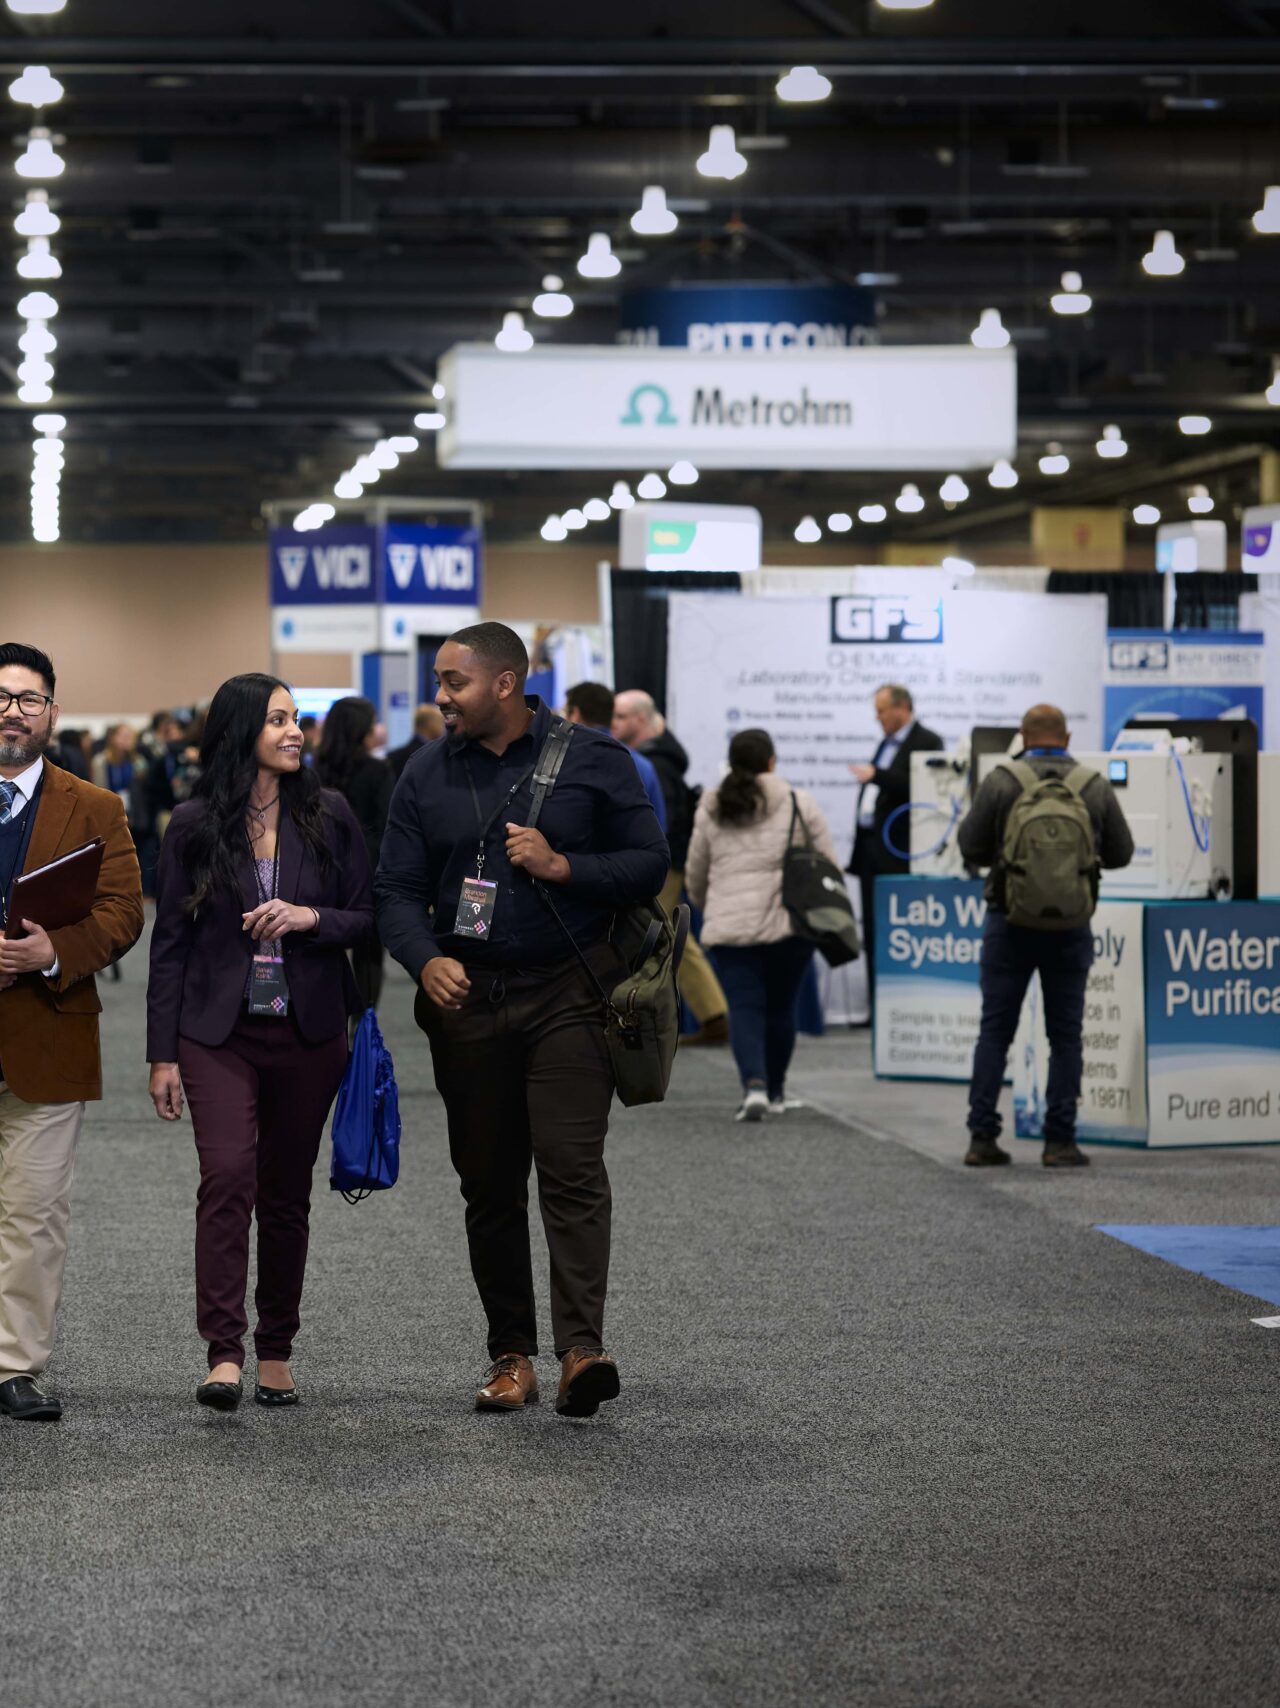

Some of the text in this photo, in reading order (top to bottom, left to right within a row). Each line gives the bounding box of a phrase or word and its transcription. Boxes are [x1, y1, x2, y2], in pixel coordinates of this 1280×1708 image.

[691, 387, 853, 427] Metrohm
[834, 598, 939, 641] GFS
[889, 893, 947, 927] Lab
[1165, 928, 1280, 972] Water
[1168, 1089, 1270, 1121] Pure and
